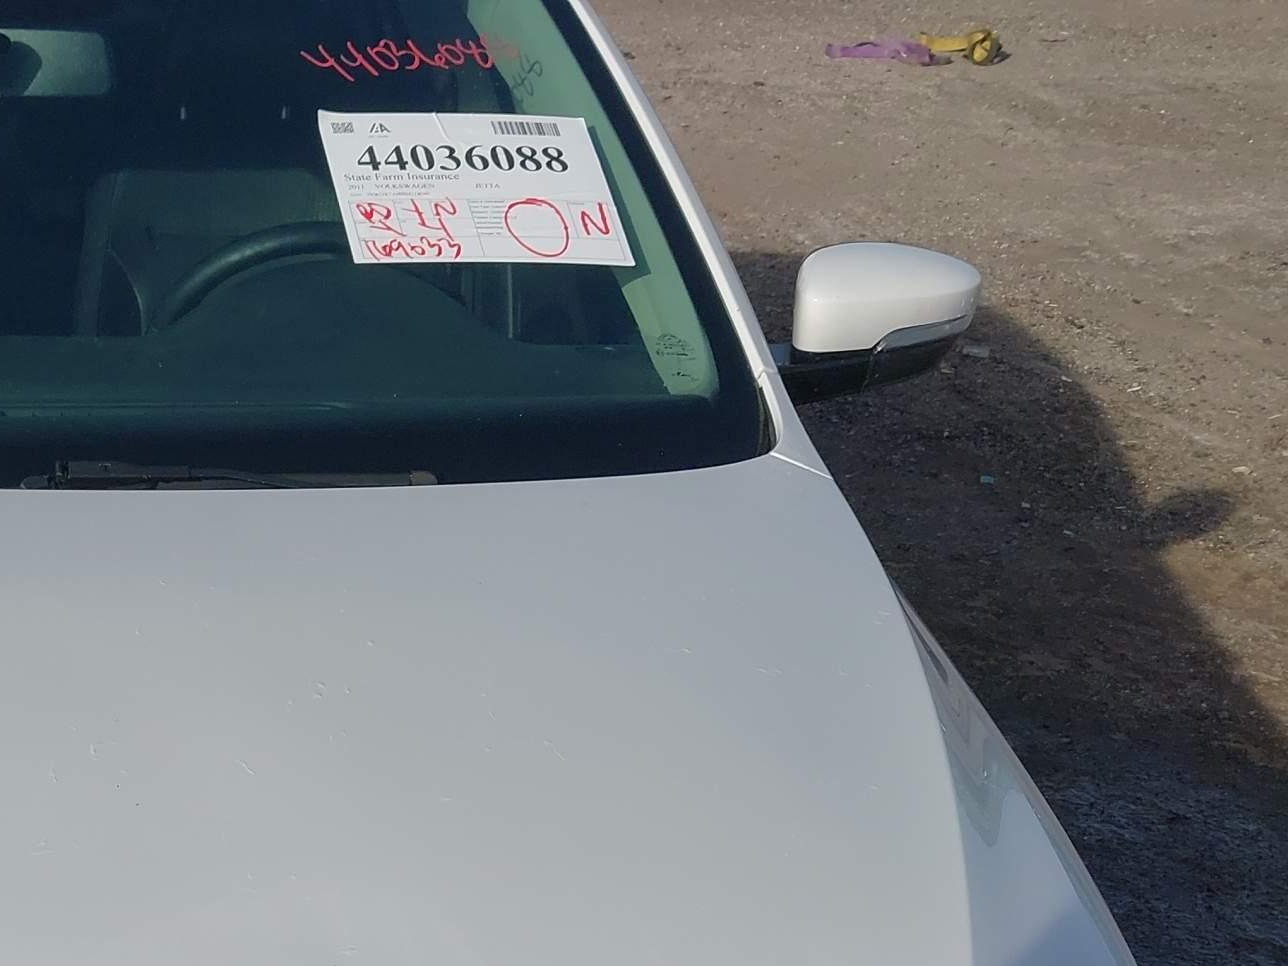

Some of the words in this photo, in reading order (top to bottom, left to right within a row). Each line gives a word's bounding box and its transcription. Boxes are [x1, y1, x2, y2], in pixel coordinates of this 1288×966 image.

[357, 143, 569, 173] 44036088
[344, 173, 371, 182] State
[375, 173, 403, 181] Farm
[407, 172, 460, 181] Insurance
